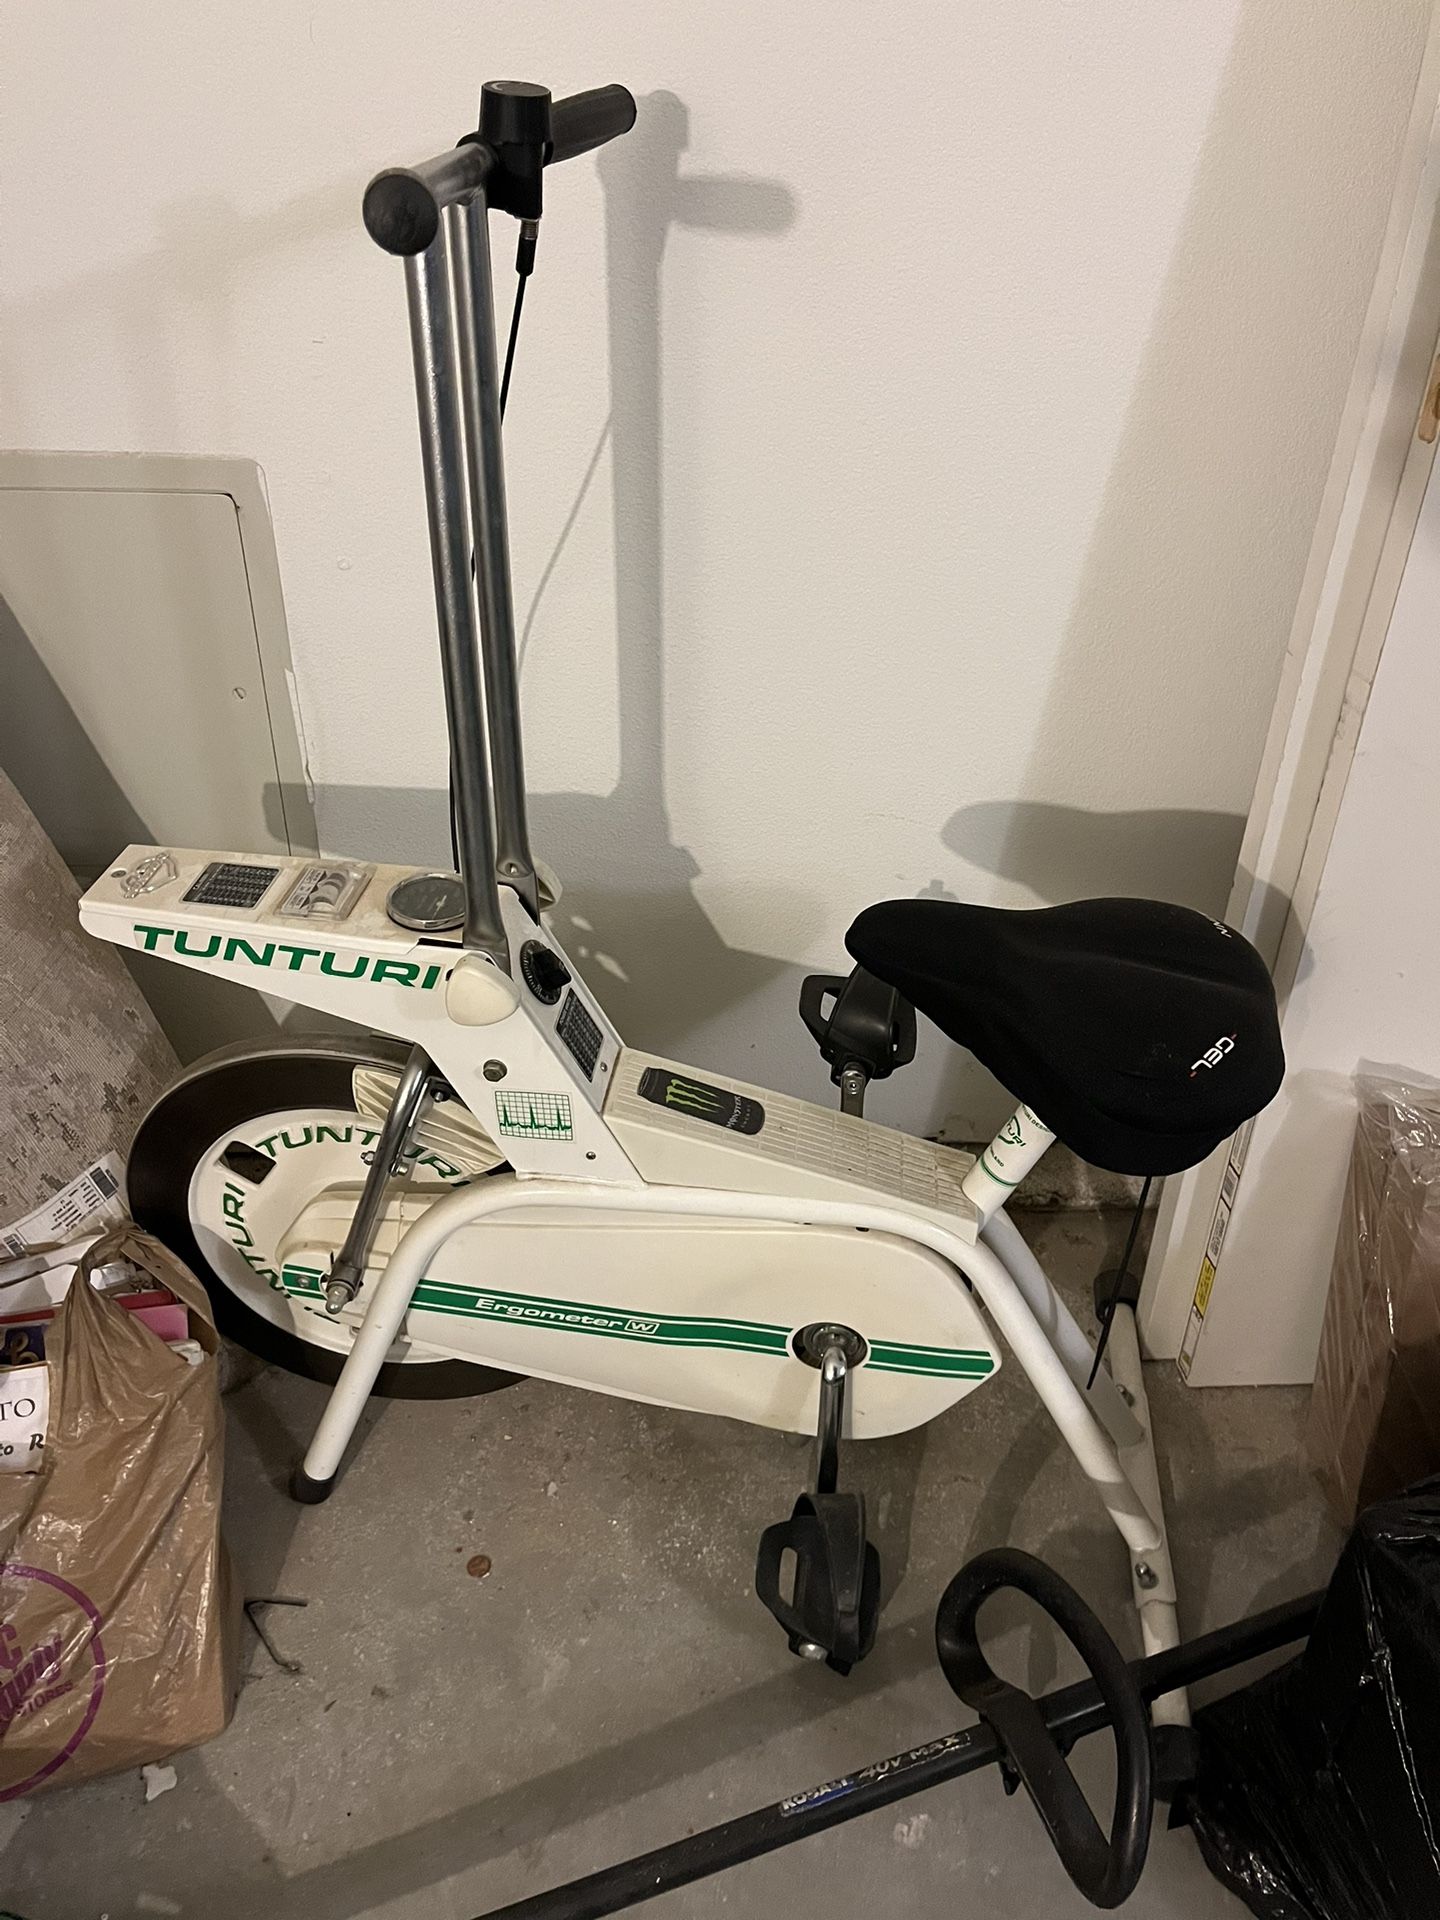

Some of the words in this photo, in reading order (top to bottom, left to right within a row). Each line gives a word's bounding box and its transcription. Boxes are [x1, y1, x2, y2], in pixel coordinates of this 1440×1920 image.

[133, 924, 441, 989] TUNTURI
[1191, 1037, 1235, 1070] GEL
[475, 1298, 623, 1328] Ergometer
[910, 1735, 959, 1760] MAX
